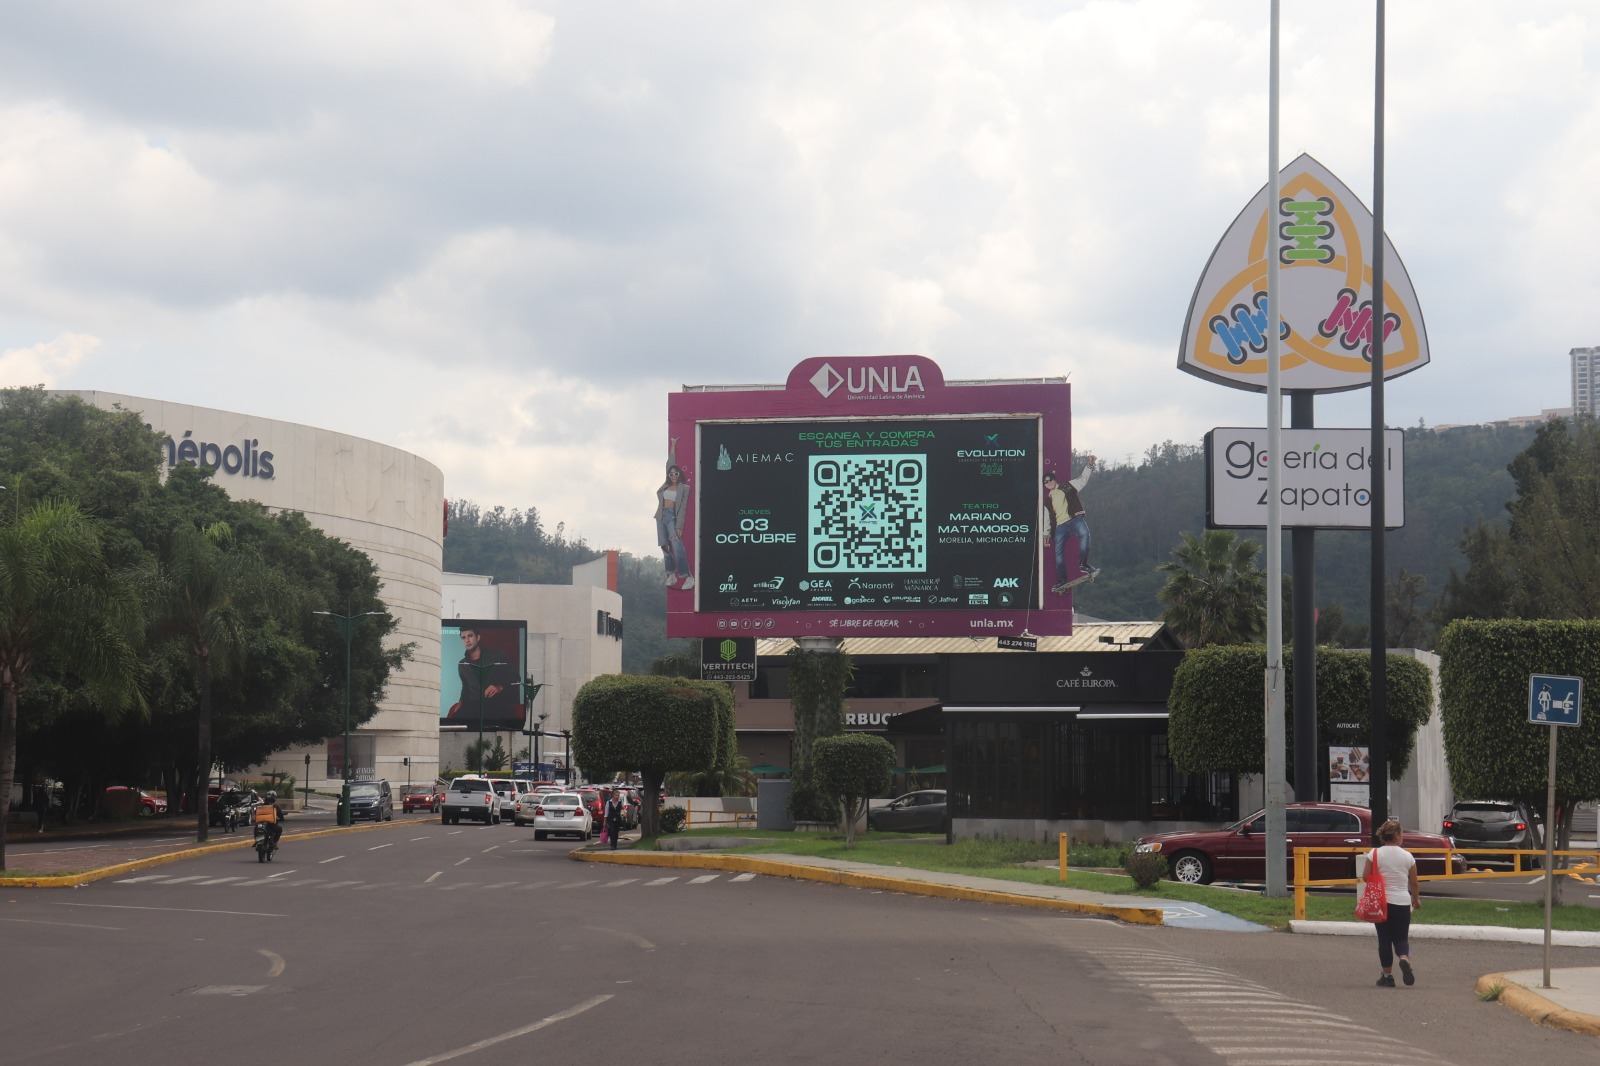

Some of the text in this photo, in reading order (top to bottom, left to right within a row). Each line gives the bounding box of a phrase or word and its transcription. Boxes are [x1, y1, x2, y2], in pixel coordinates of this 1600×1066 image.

[847, 366, 925, 393] UNLA
[798, 430, 936, 440] ESCANEA Y COMPRA
[816, 439, 919, 448] TUS ENTRADAS
[736, 453, 794, 462] AIEMAC
[957, 449, 1026, 457] EVOLUTION
[1346, 446, 1392, 471] dl
[949, 512, 1012, 521] MARIANO
[740, 518, 769, 531] 03
[938, 524, 1029, 533] MATAMOROS
[715, 533, 796, 544] OCTUBRE
[976, 535, 1026, 543] MICHOACÁN
[719, 582, 738, 592] gnu
[810, 580, 832, 588] GEA
[993, 577, 1019, 588] AAK
[771, 596, 800, 608] Viscofan
[840, 620, 861, 628] LIBRE
[874, 619, 899, 628] CREAR
[970, 618, 1014, 628] unla.mx
[702, 662, 754, 670] VERTITECH
[1056, 678, 1080, 688] CAFÉ
